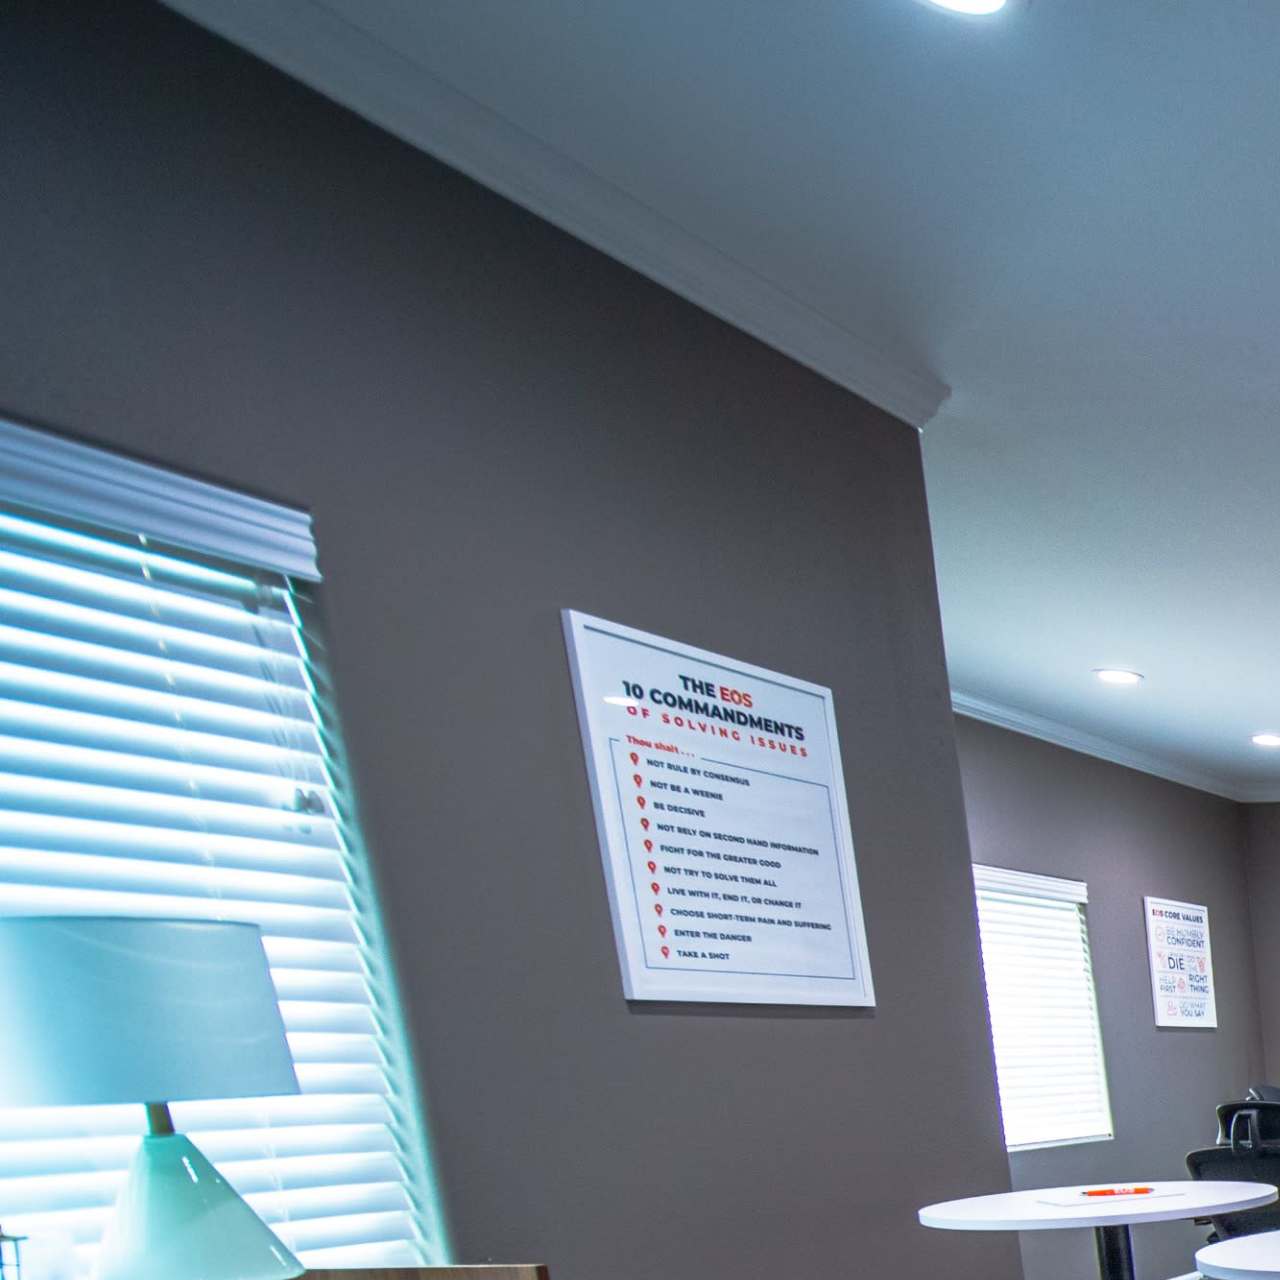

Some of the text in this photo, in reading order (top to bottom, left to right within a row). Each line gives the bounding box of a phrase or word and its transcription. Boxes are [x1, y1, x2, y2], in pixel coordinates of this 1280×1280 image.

[678, 674, 753, 708] THE EOS
[622, 680, 805, 741] 10 COMMANDMENTS
[626, 705, 808, 757] OF SOLVING ISSUES
[626, 735, 652, 748] Thou
[647, 759, 750, 786] NOT RULE BY CONSENSUS
[650, 780, 724, 801] NOT BE A WEENIE
[653, 801, 705, 818] BE DECISIVE
[657, 823, 819, 856] NOT RELY ON SECOND HAND INFORMATION
[660, 844, 782, 869] FIGHT FOR THE GREATER GOOD
[664, 866, 778, 888] NOT TRY TO SOLVE THEM ALL
[667, 887, 686, 896] LIVE
[688, 889, 710, 899] WITH
[722, 893, 739, 902] END
[751, 896, 762, 904] OR
[763, 898, 793, 908] CHANGE
[670, 908, 831, 930] CHOOSE SHORT-TERM PAIN AND SUFFERING
[1164, 911, 1180, 920] CORE
[1181, 913, 1203, 923] VALUES
[674, 929, 753, 942] ENTER THE DANGER
[1166, 936, 1204, 948] CONFIDENT
[677, 950, 699, 959] TAKE
[709, 952, 730, 960] SHOT
[1168, 956, 1185, 970] DIE
